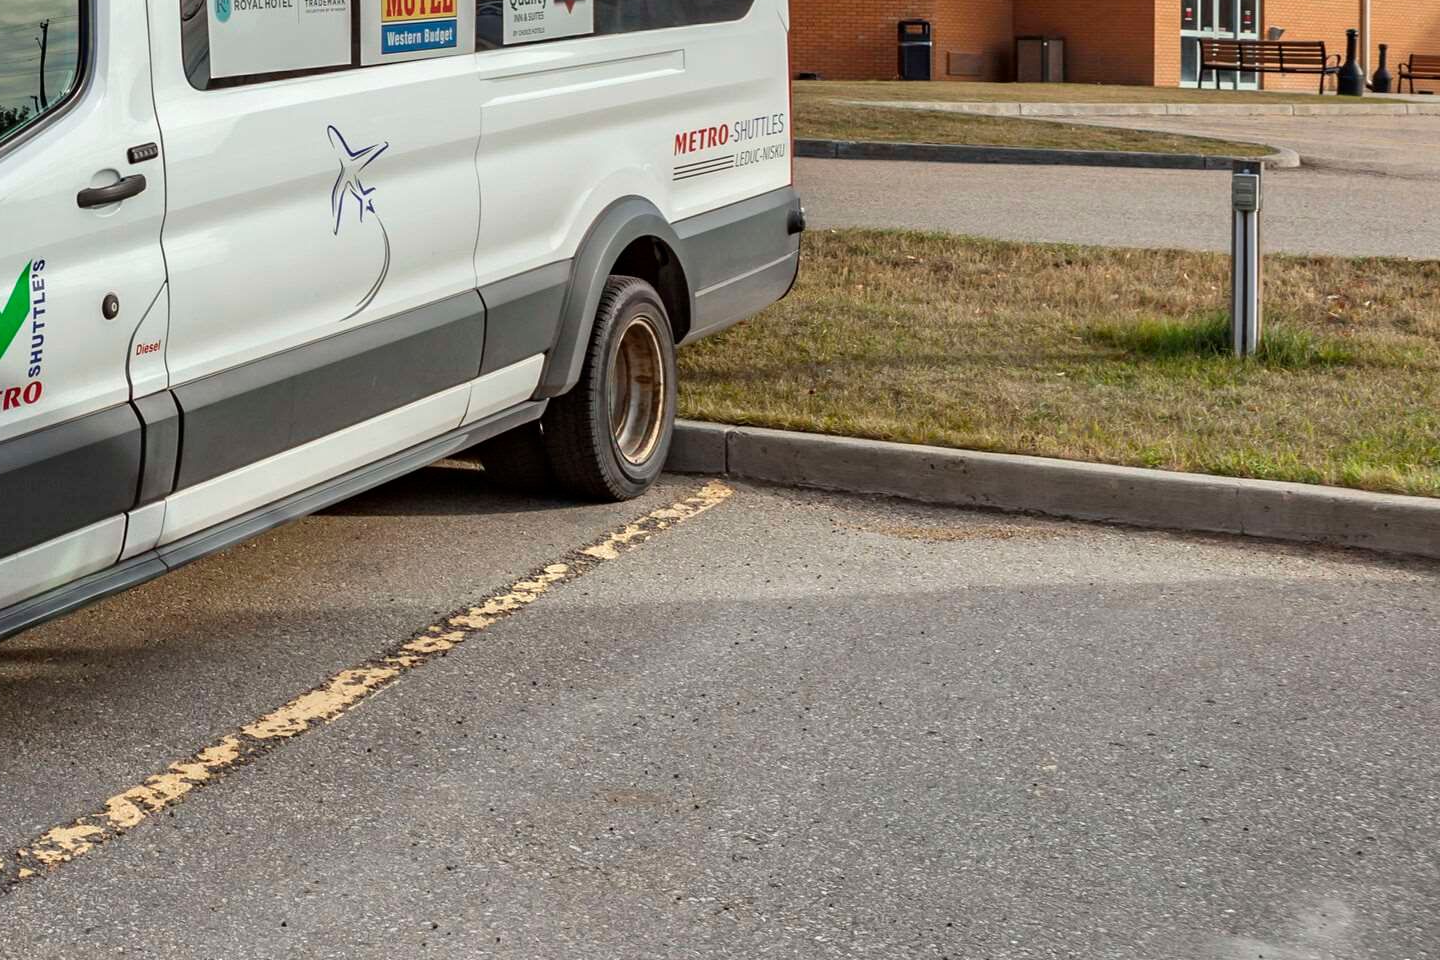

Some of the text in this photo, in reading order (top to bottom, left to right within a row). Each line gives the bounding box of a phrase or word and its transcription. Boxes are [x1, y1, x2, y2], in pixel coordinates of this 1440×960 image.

[234, 0, 263, 11] ROYAL
[387, 27, 453, 46] Western Budget
[674, 113, 784, 156] METRO-SHUTTLES
[735, 144, 785, 167] LEDUC-NISKU
[28, 259, 45, 378] SHUTTLE'S
[136, 340, 161, 355] Diesel
